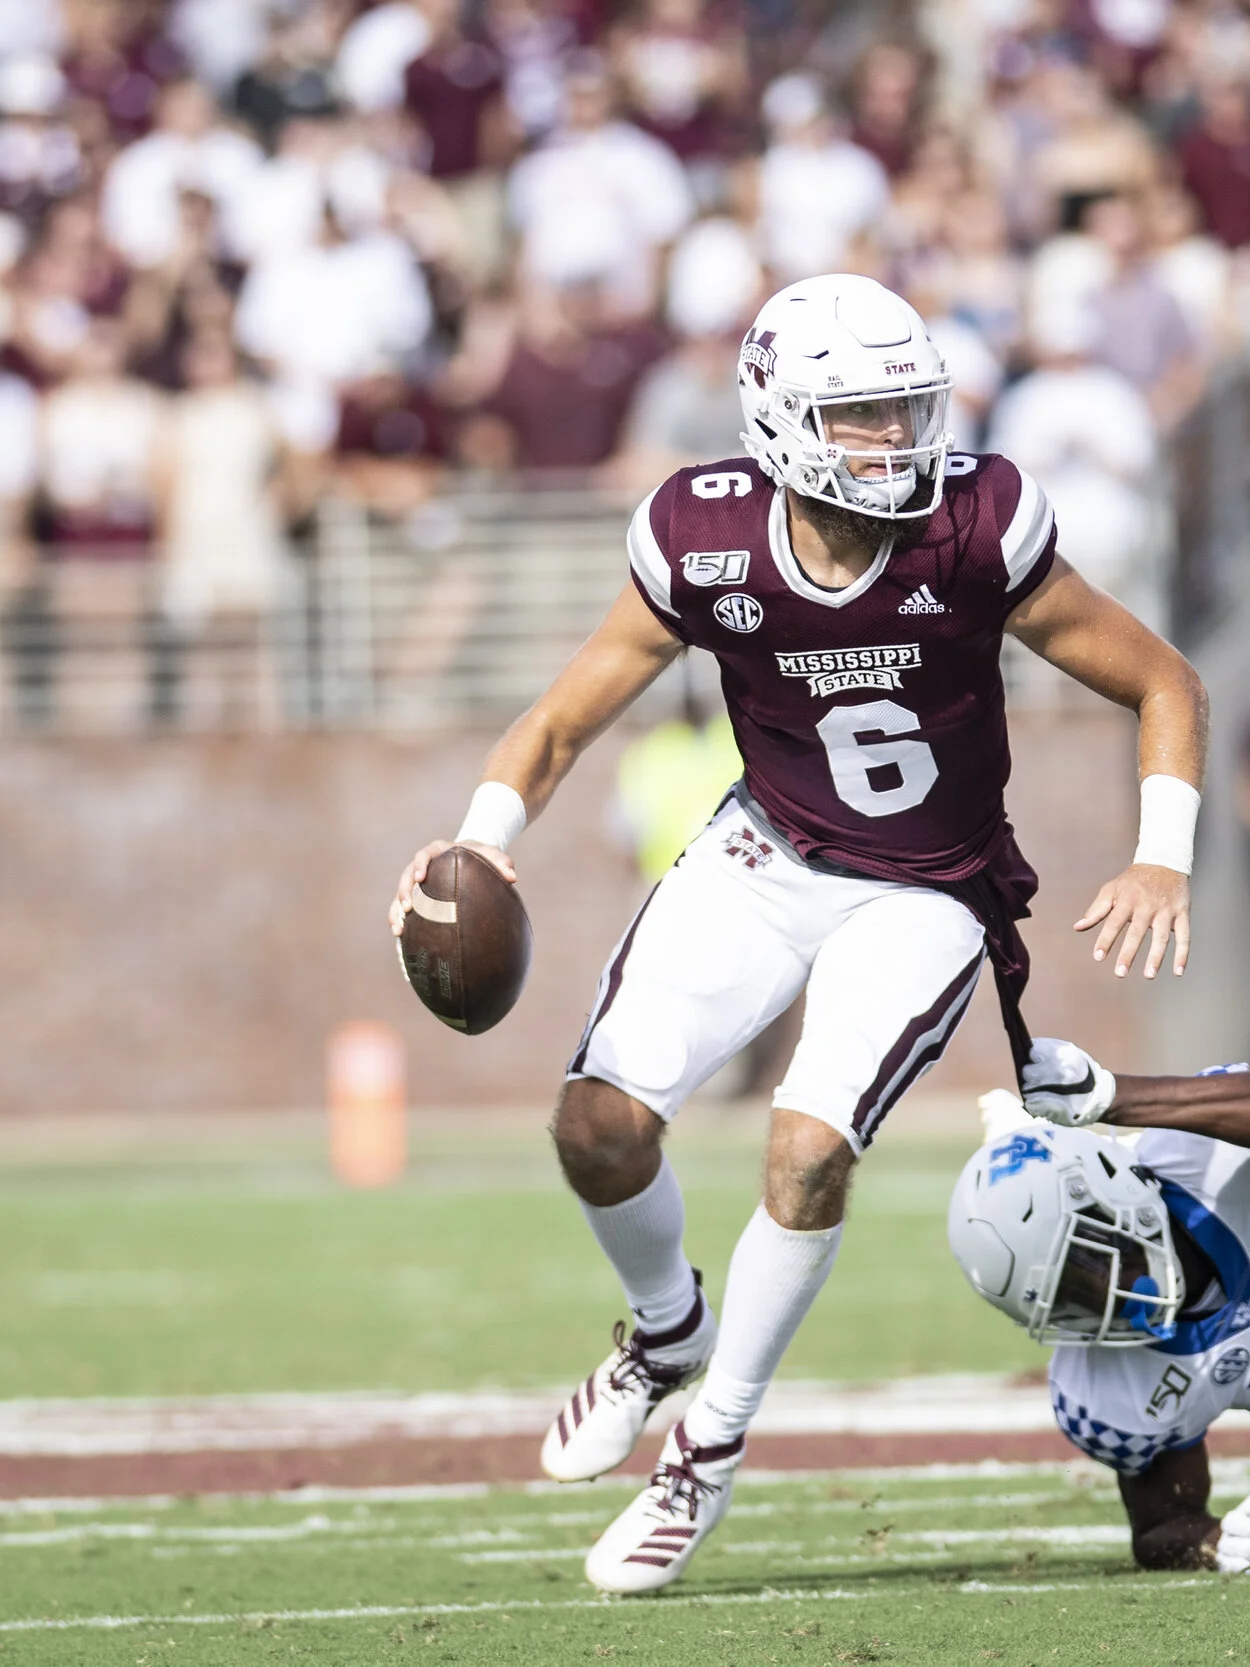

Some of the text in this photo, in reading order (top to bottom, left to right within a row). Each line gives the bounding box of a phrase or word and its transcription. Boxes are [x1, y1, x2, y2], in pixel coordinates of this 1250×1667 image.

[884, 362, 916, 375] STATE
[691, 471, 752, 499] 6
[680, 550, 750, 586] 150
[715, 594, 762, 632] SEC
[898, 601, 945, 614] adidas
[776, 646, 922, 674] MISSISSIPPI
[823, 672, 886, 691] STATE
[815, 699, 940, 817] 6
[735, 839, 766, 864] STATE
[1146, 1363, 1192, 1420] 150
